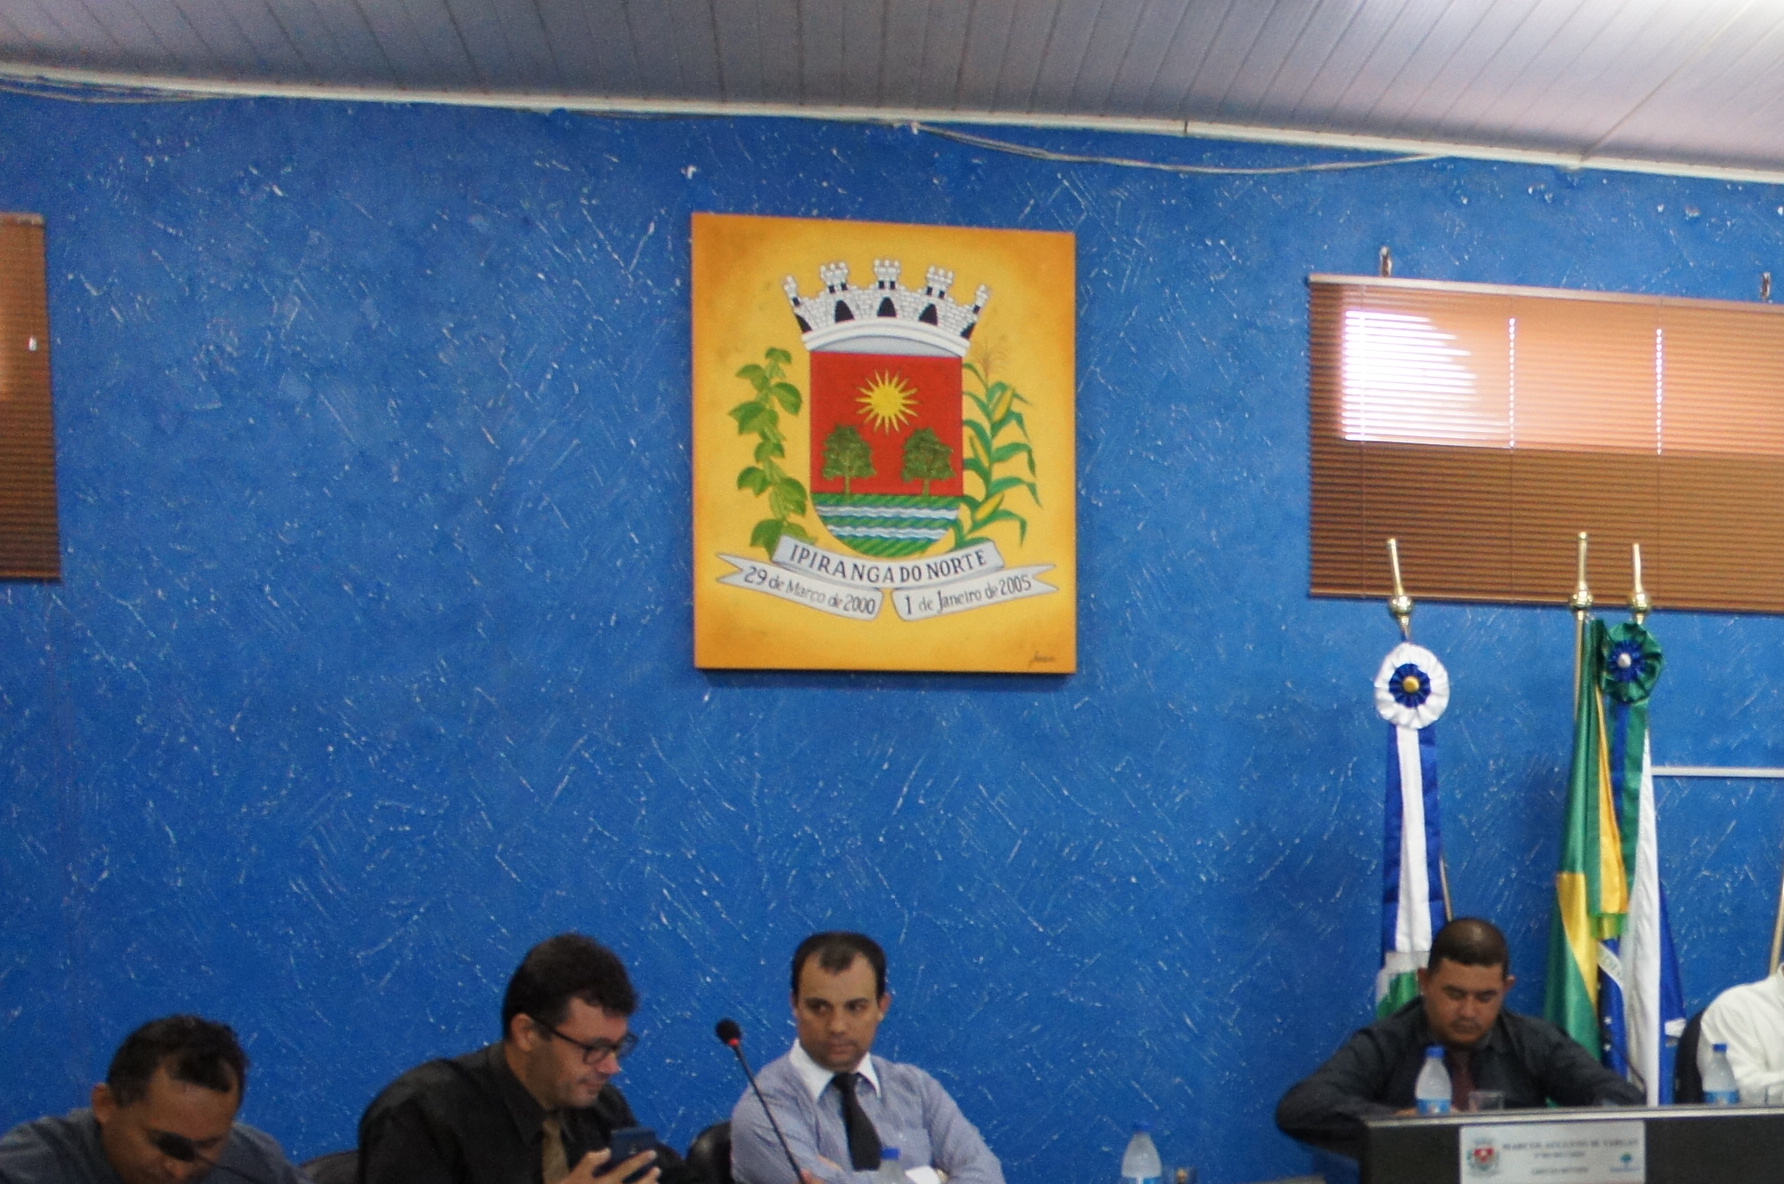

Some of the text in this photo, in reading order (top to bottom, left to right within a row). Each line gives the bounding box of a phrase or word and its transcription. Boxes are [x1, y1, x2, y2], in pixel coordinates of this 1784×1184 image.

[790, 545, 986, 583] IPIRANGA DO NORTE
[744, 566, 768, 586] 29
[768, 575, 784, 590] de
[828, 593, 842, 608] de
[843, 594, 876, 615] 2000
[905, 575, 1032, 615] 1 de Janeiro de 2005
